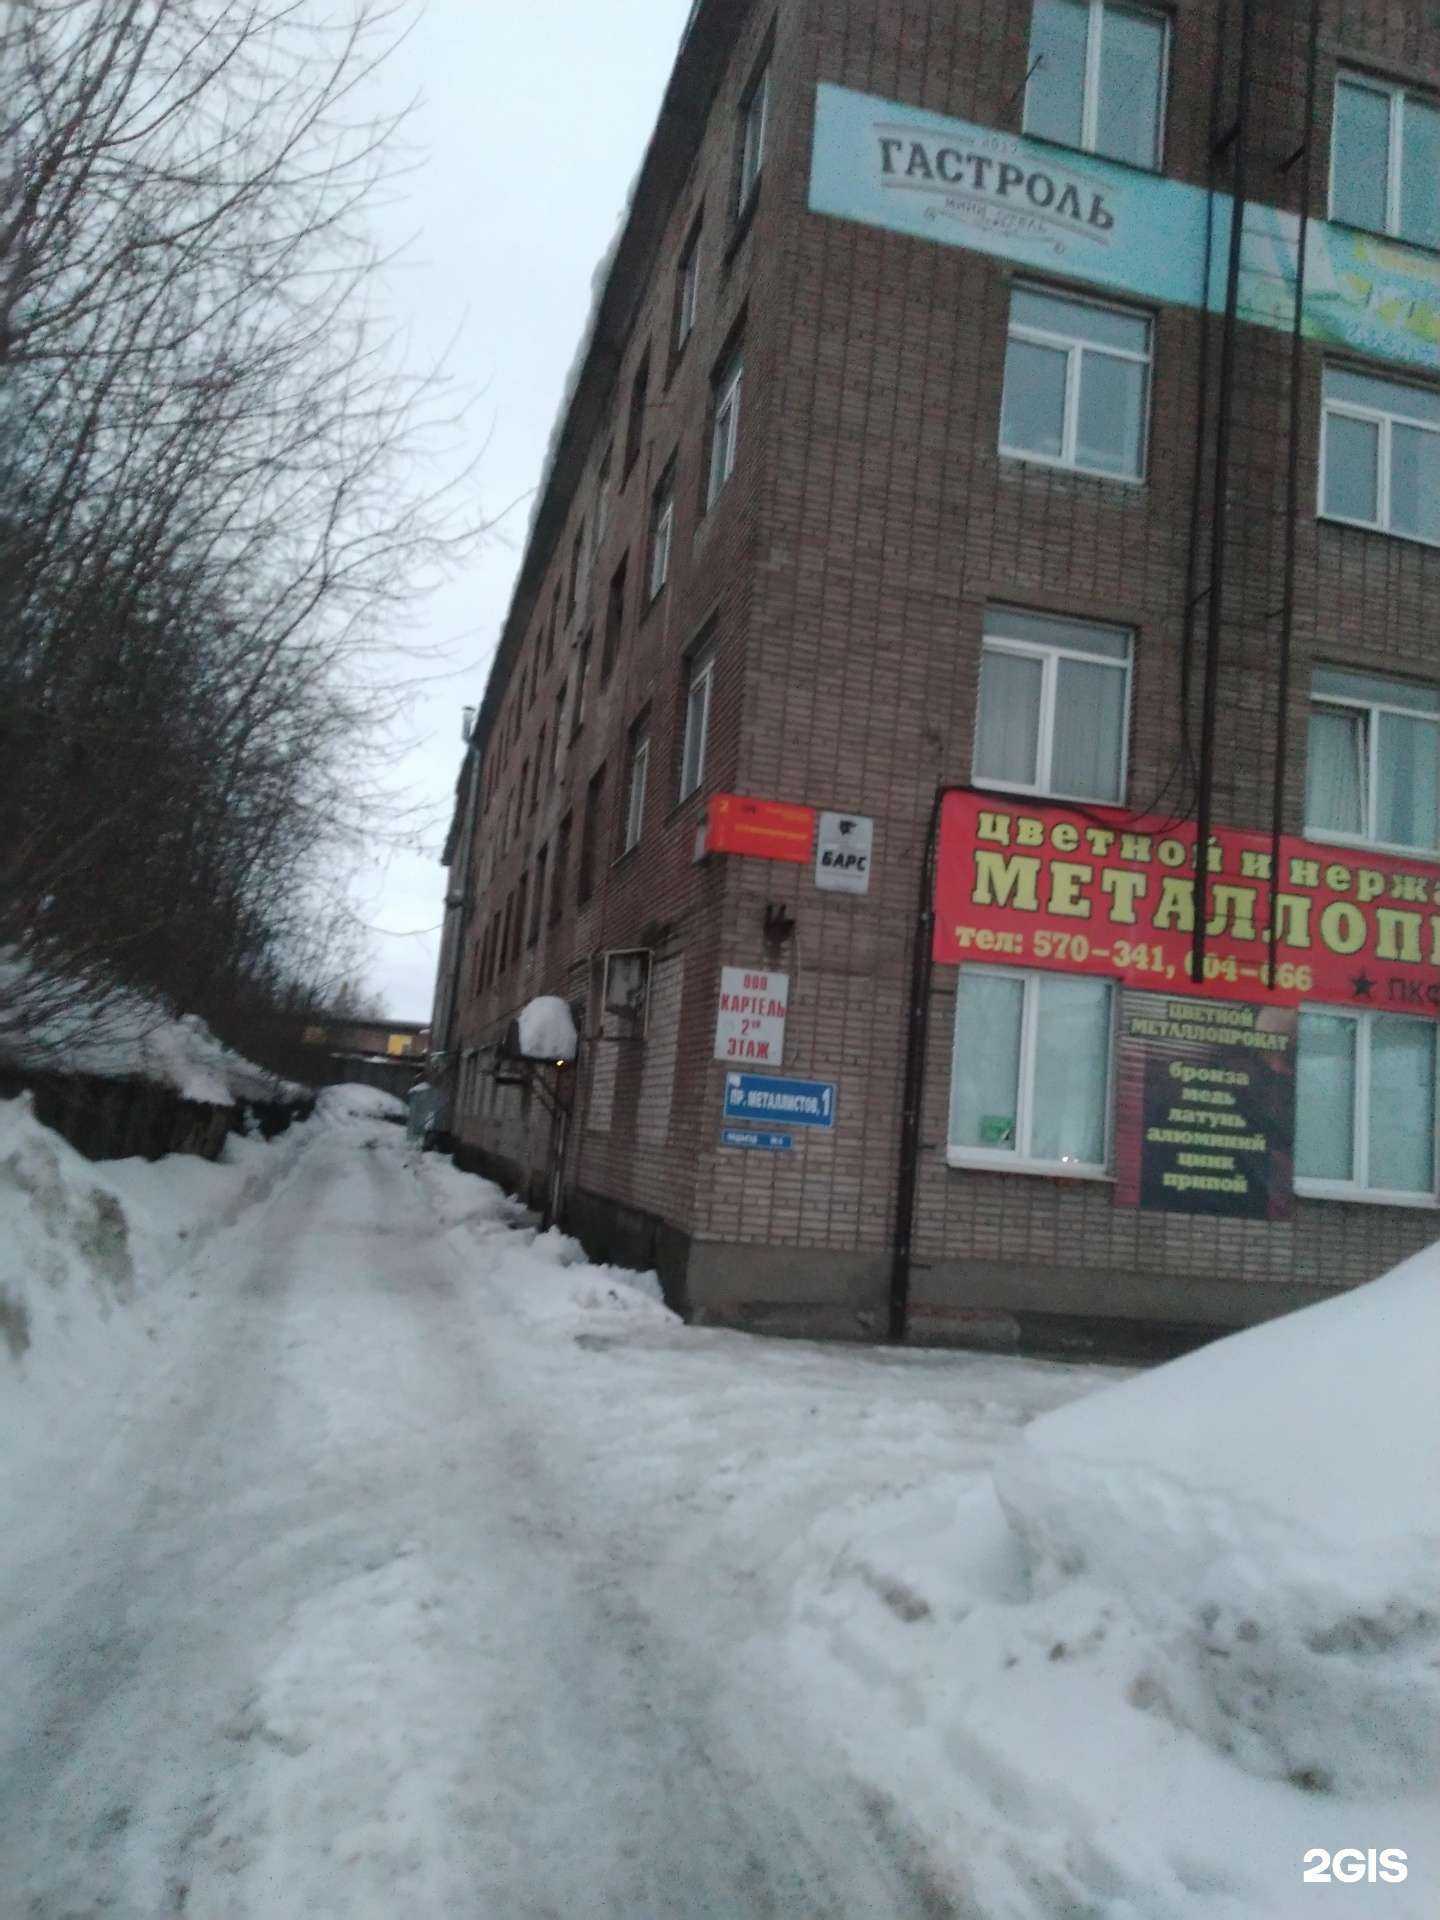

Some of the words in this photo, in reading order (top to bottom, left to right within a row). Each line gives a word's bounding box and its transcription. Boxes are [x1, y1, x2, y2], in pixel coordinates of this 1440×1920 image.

[878, 136, 1115, 230] ГАСТРОЛЬ
[821, 851, 867, 871] БАРС
[720, 992, 786, 1018] КАРТЕЛЬ
[726, 1037, 771, 1060] ЭТАЖ
[1168, 1061, 1250, 1086] бронза
